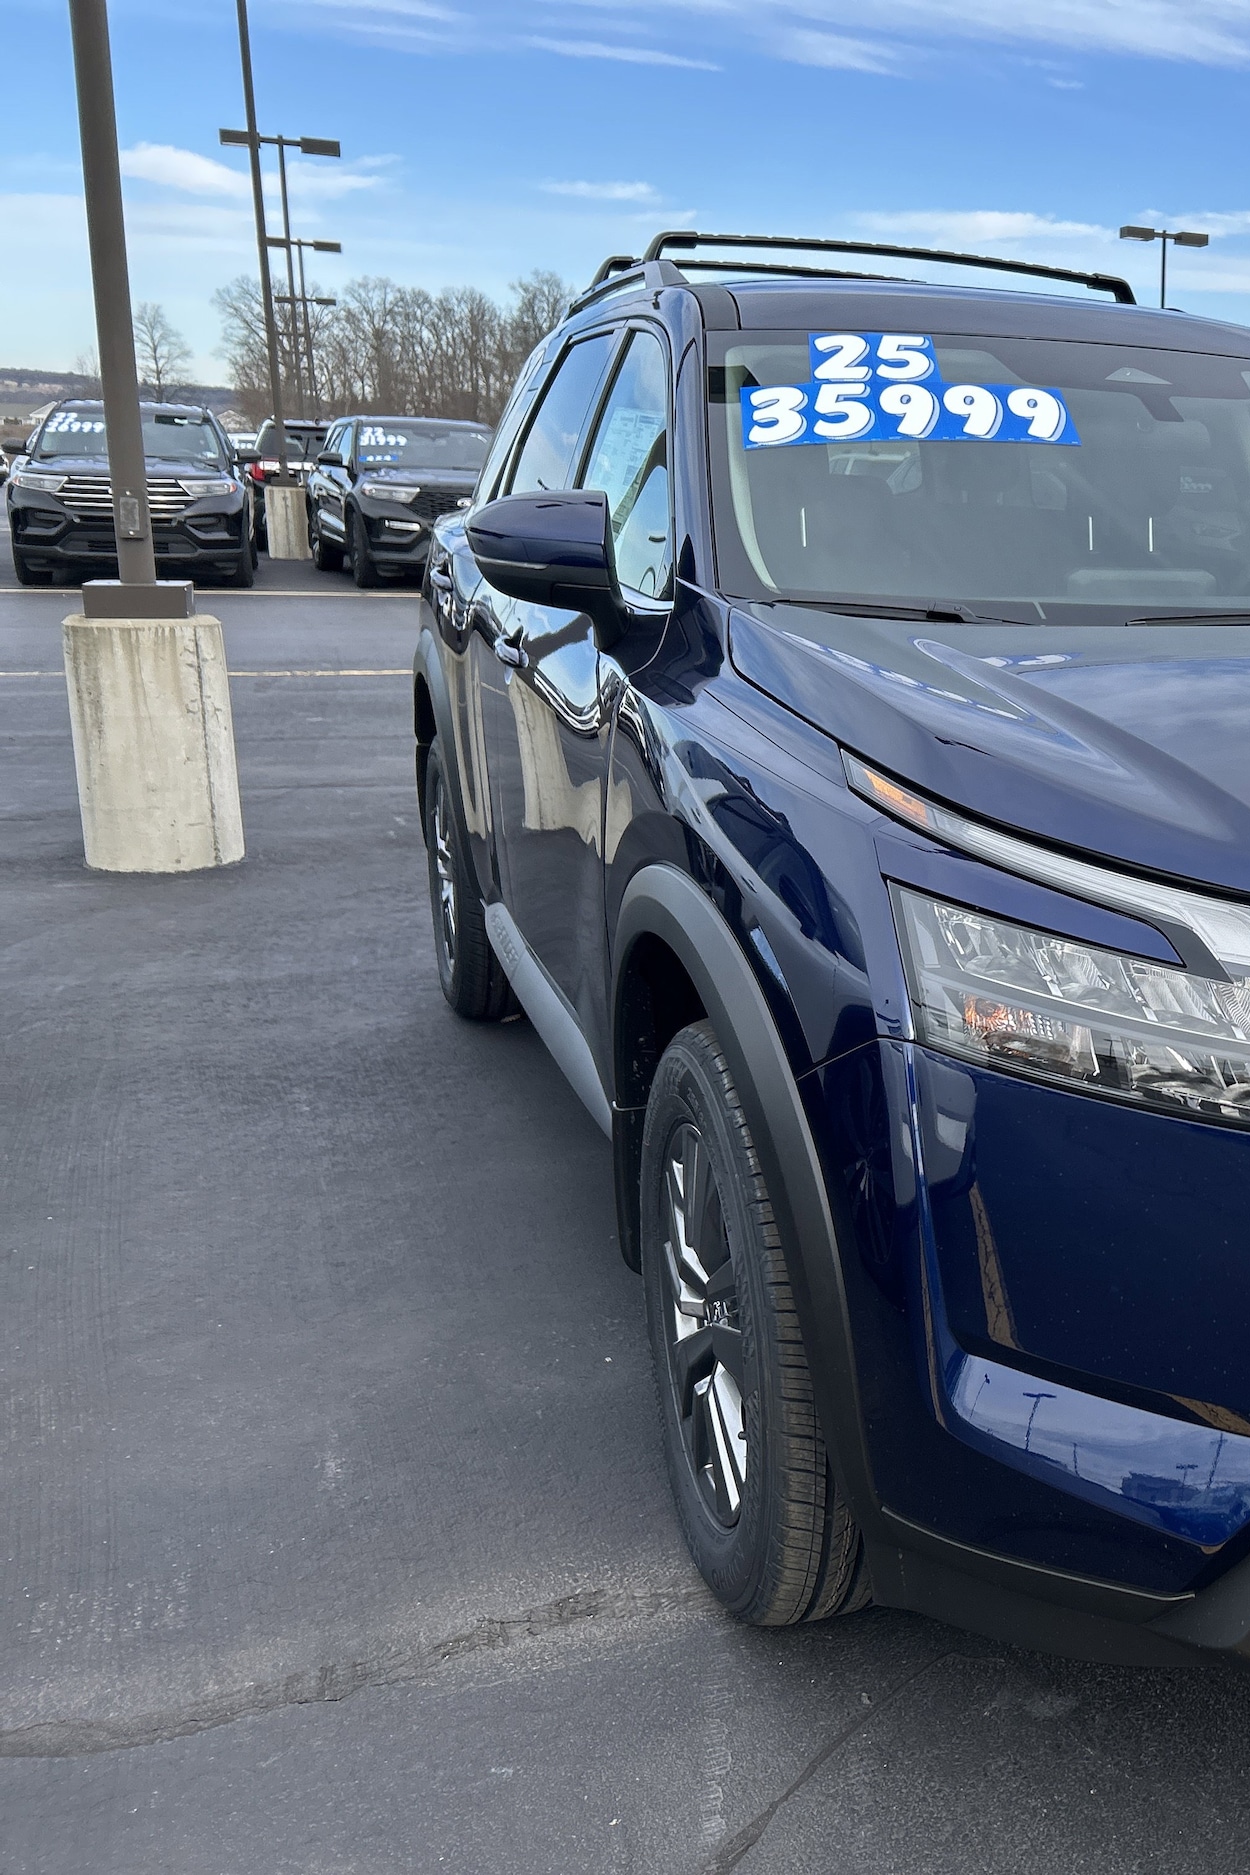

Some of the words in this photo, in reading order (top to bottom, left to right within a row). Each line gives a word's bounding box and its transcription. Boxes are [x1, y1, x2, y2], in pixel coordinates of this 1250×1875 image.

[813, 334, 935, 382] 25
[45, 421, 105, 433] 26999
[747, 382, 1067, 445] 35999
